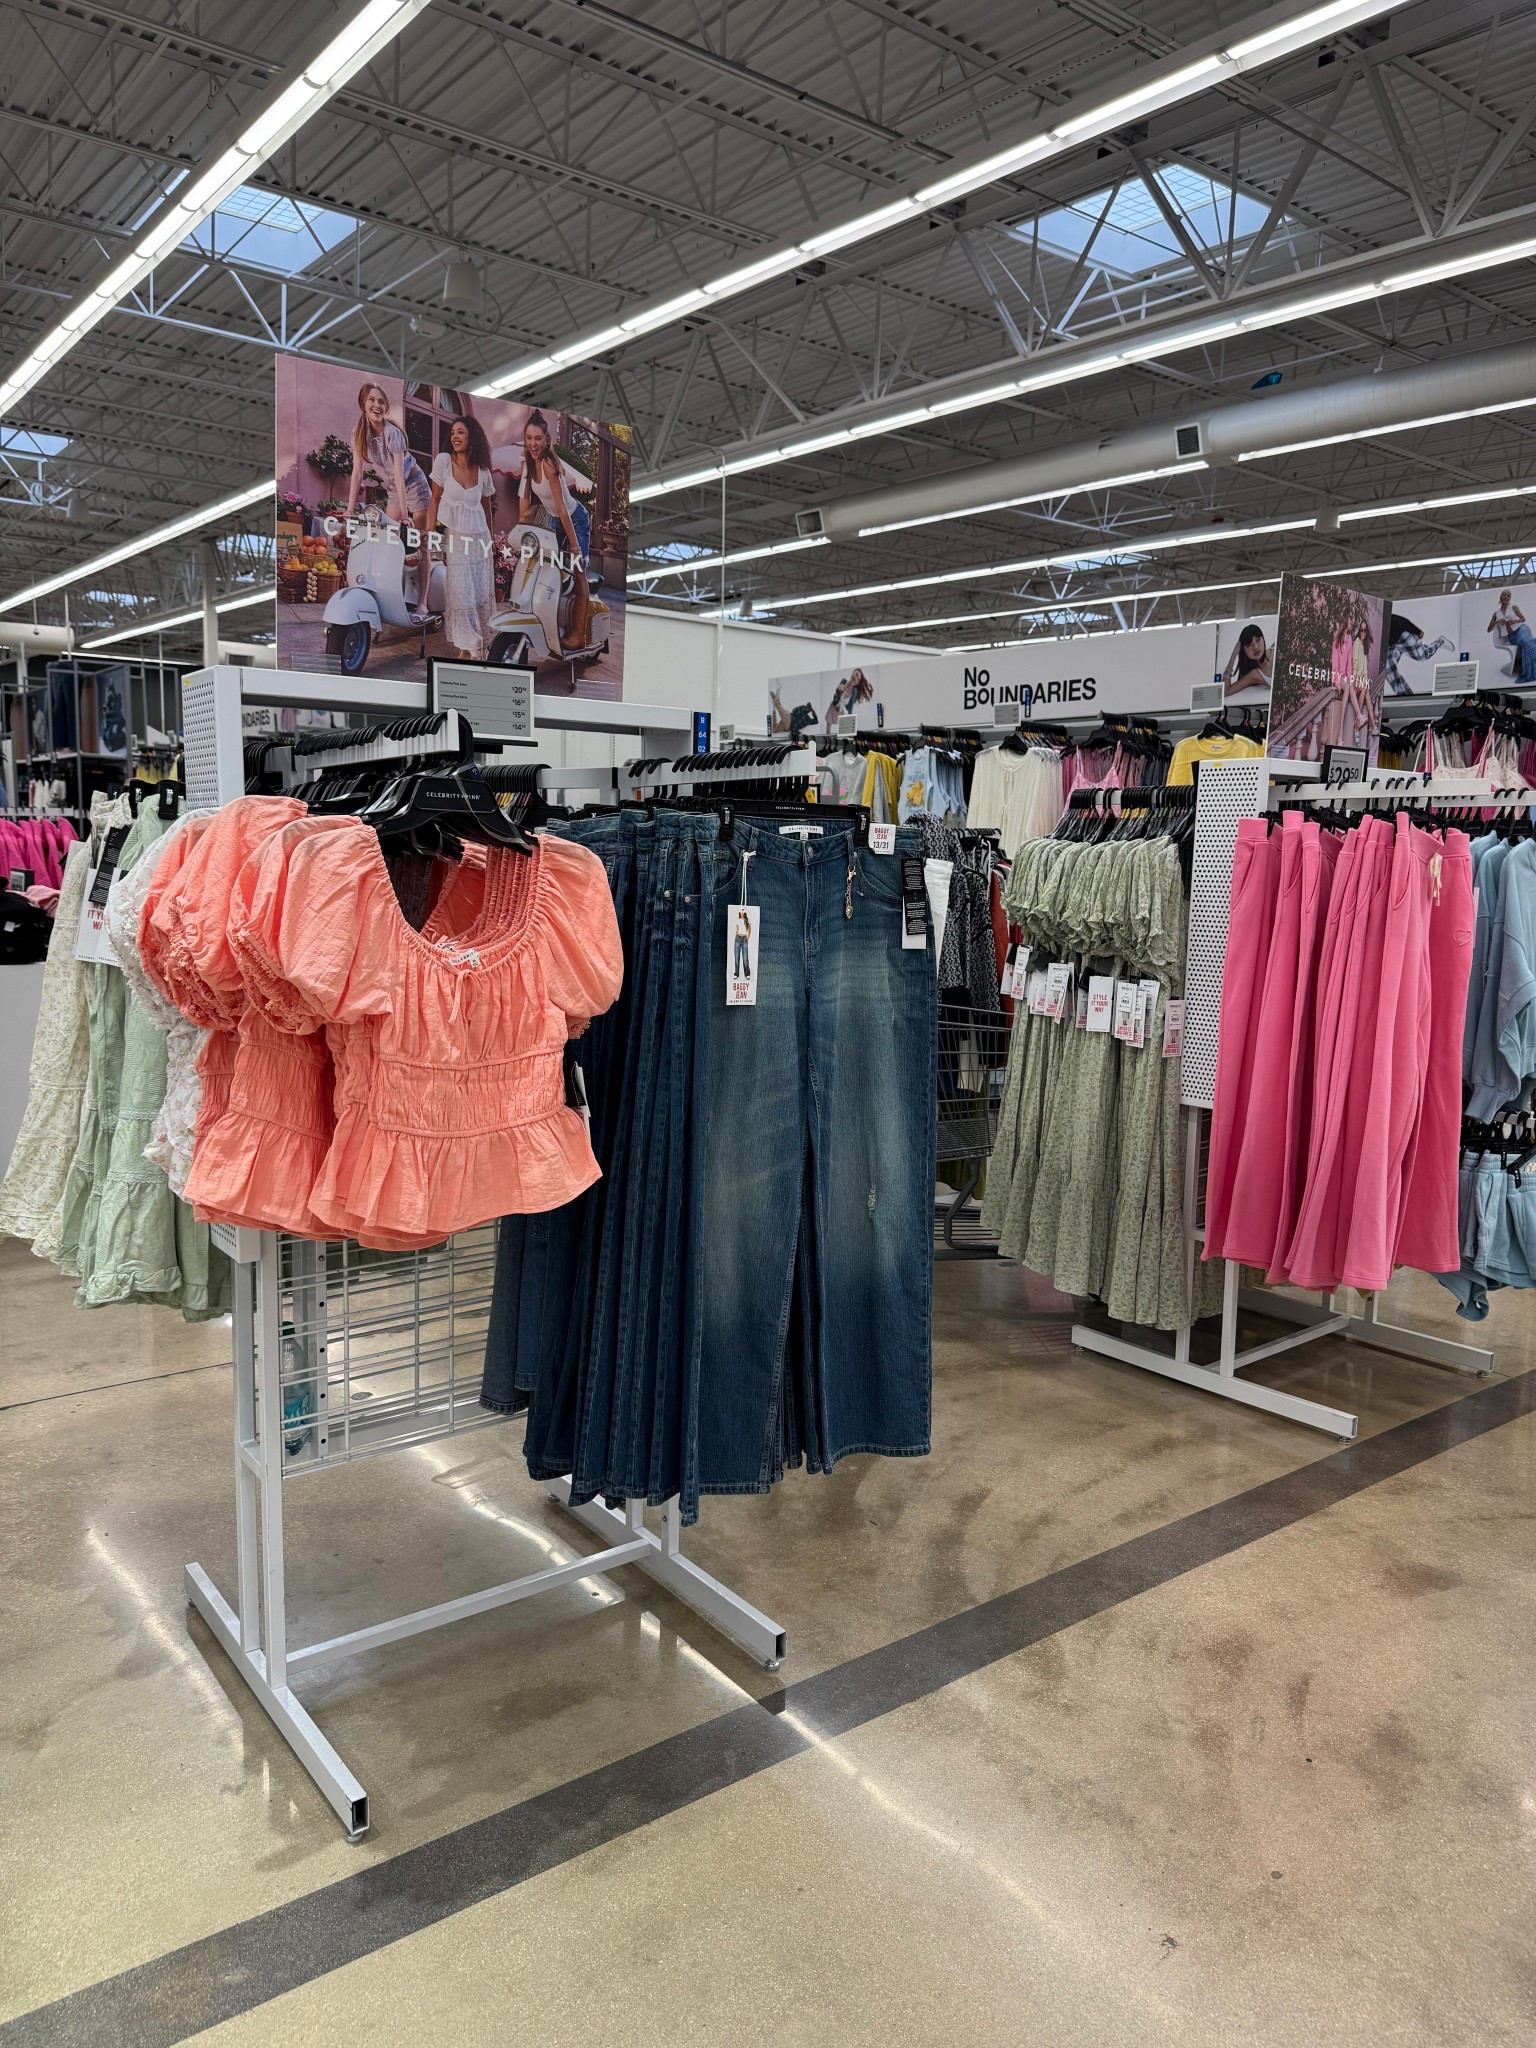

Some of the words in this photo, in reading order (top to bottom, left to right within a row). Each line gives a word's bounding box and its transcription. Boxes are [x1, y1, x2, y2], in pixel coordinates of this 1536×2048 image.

[323, 516, 494, 559] CELEBRITY
[520, 546, 583, 572] PINK
[1288, 663, 1342, 684] CELEBRITY
[1349, 676, 1371, 690] PINK
[964, 677, 1097, 710] BOUNDARIES
[697, 745, 706, 753] 02
[426, 791, 460, 799] CELEBRITY
[873, 841, 889, 849] 13/31
[733, 982, 750, 991] BAGGY
[735, 991, 747, 999] JEAN
